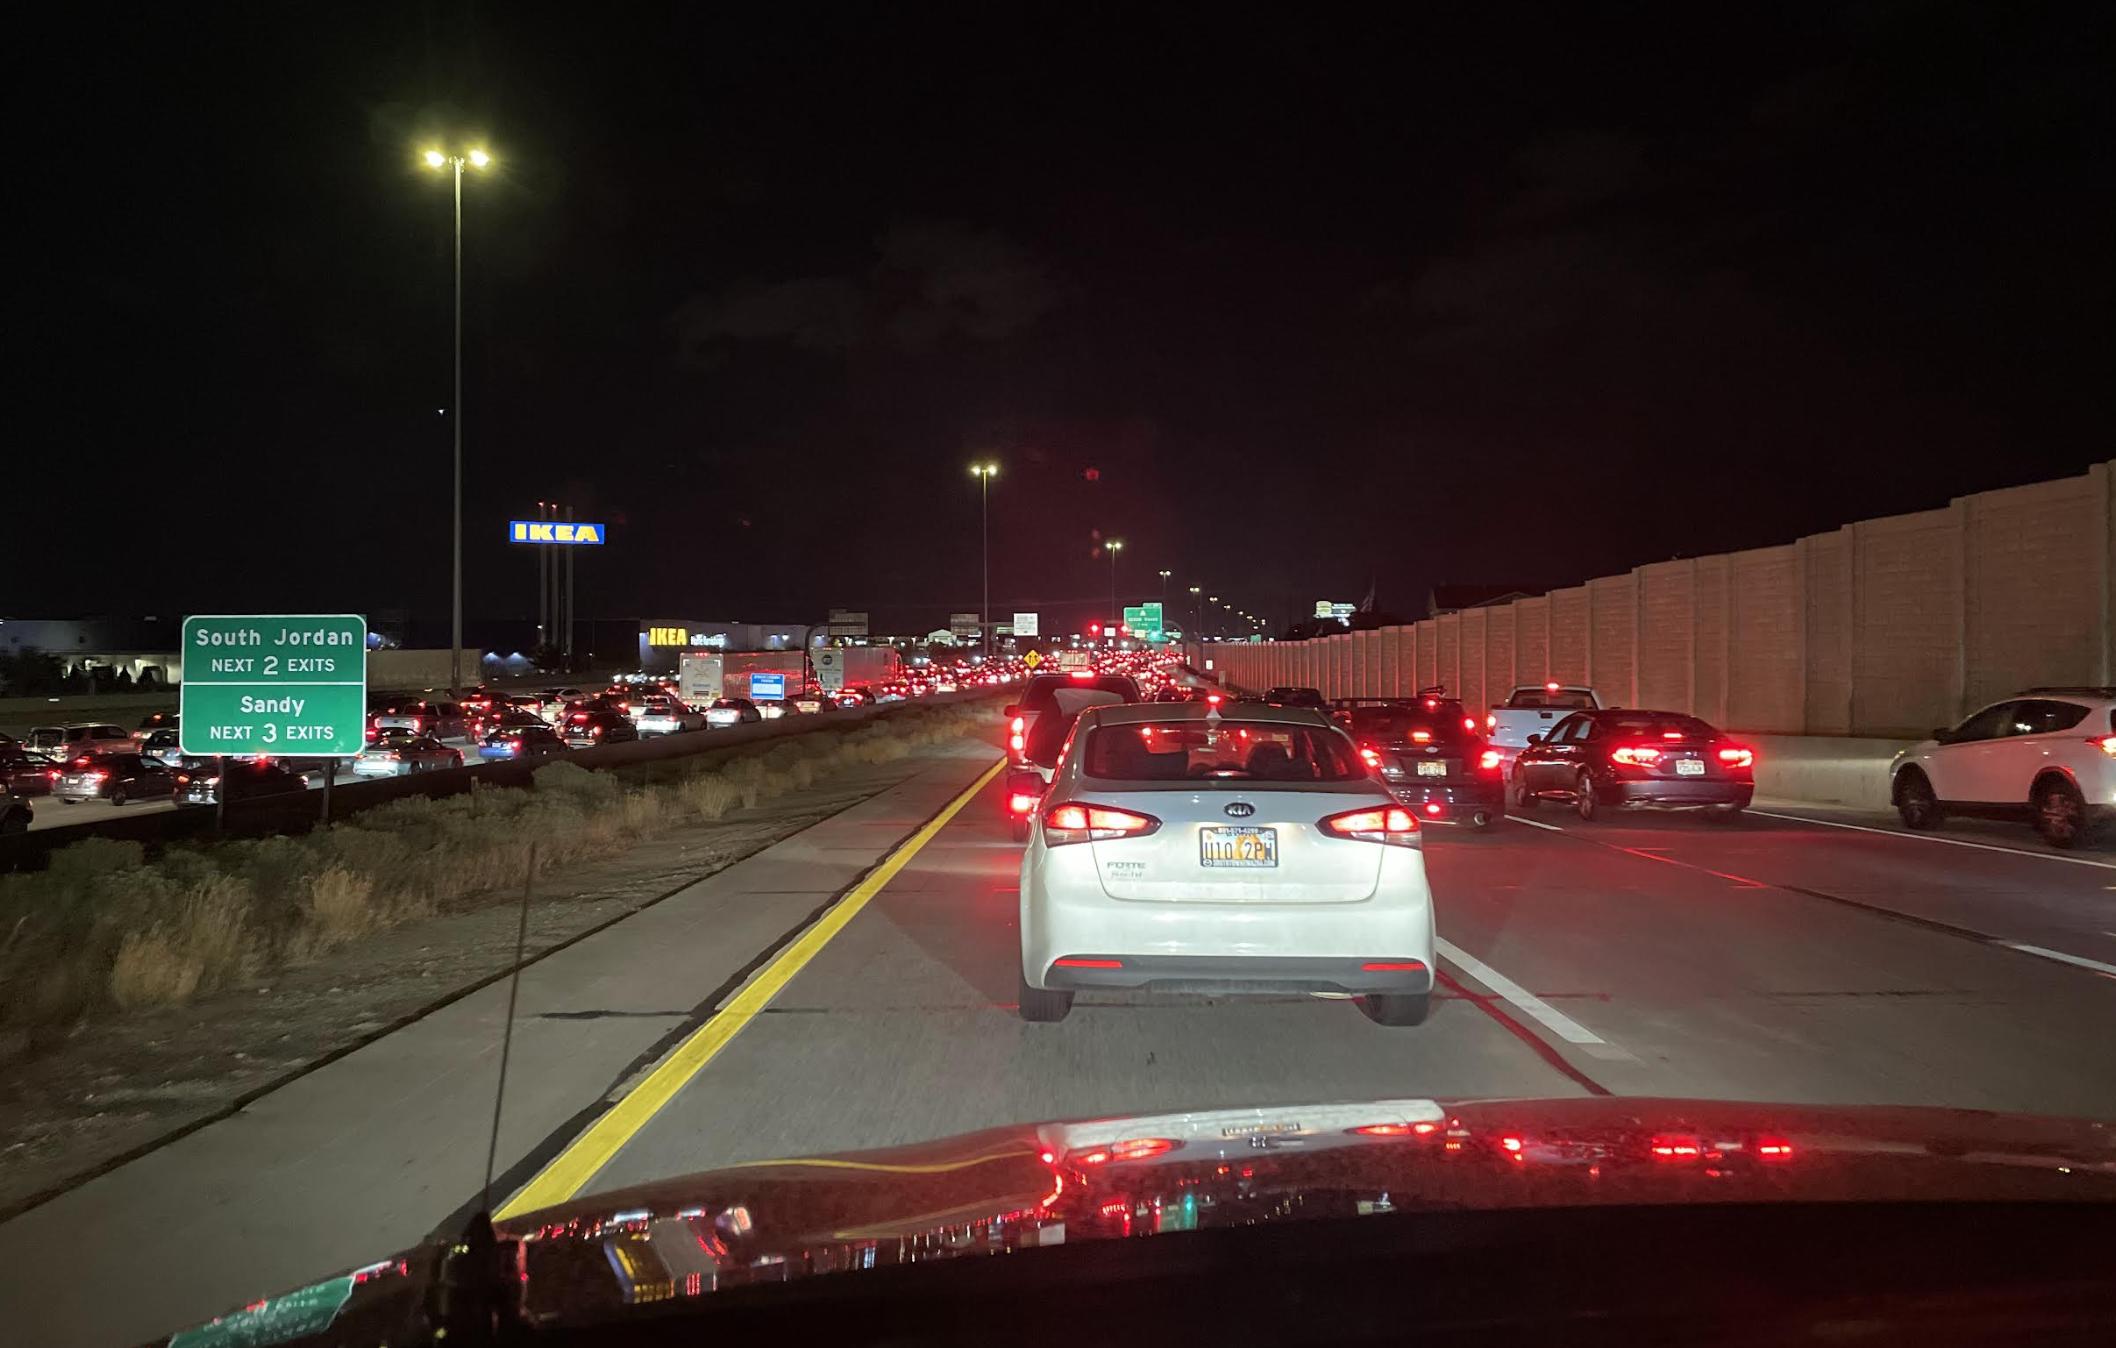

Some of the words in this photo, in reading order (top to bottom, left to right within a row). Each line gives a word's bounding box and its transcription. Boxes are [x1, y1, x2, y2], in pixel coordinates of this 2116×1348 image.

[514, 523, 599, 542] IKEA
[195, 628, 261, 646] South
[274, 628, 353, 646] Jordan
[648, 627, 688, 646] IKEA
[211, 658, 254, 672] NEXT
[263, 655, 279, 675] 2
[287, 658, 335, 672] EXITS
[240, 695, 305, 717] Sandy
[210, 726, 253, 739] NEXT
[262, 723, 277, 743] 3
[286, 726, 334, 739] EXITS
[1227, 804, 1252, 816] KIA
